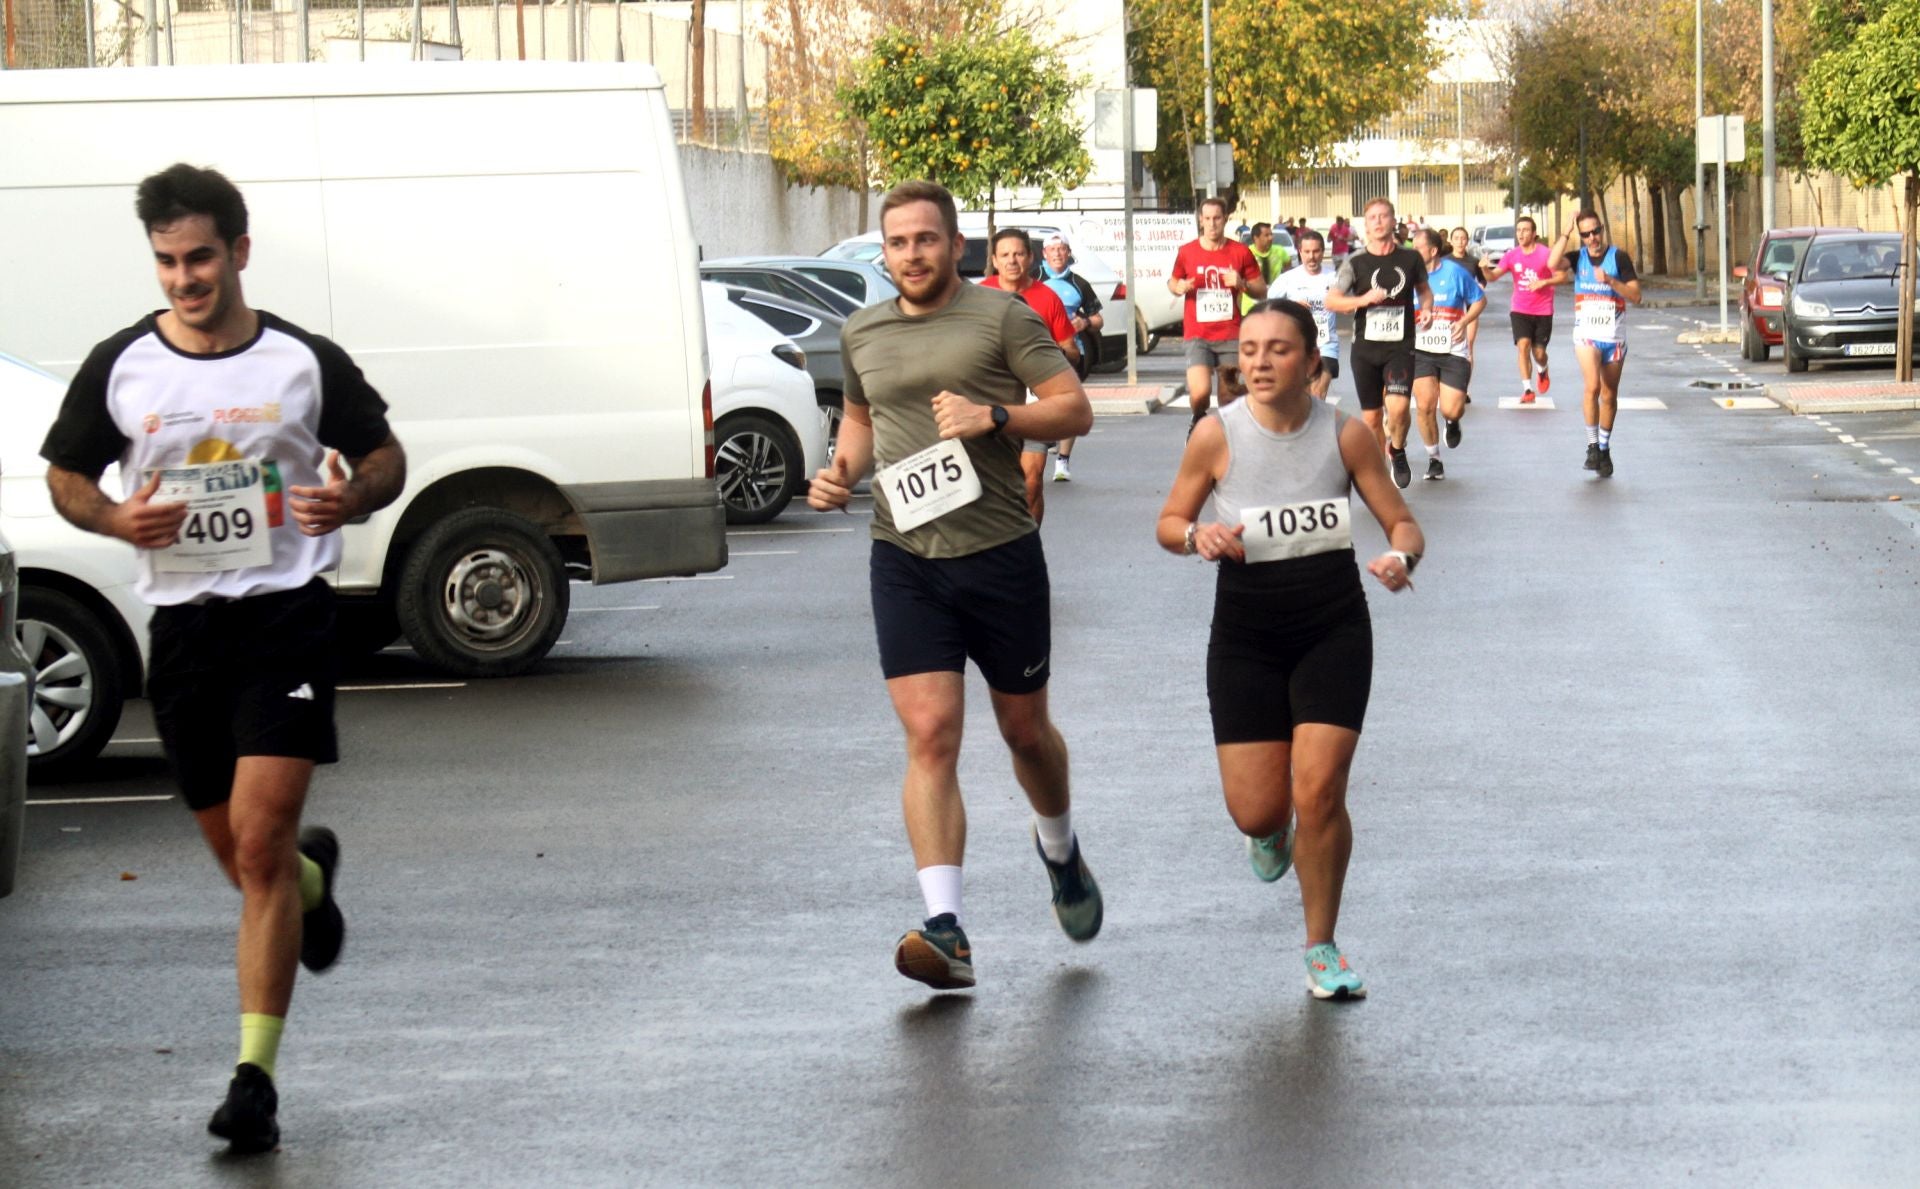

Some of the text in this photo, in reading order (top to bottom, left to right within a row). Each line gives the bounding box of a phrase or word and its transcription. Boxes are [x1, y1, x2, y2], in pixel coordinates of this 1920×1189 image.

[1135, 217, 1192, 226] PERFORACIONES
[1147, 230, 1185, 241] JUAREZ
[1203, 303, 1229, 313] 1532
[1420, 335, 1448, 346] 1009
[896, 454, 962, 504] 1075
[1259, 503, 1338, 537] 1036
[174, 507, 253, 545] 409
